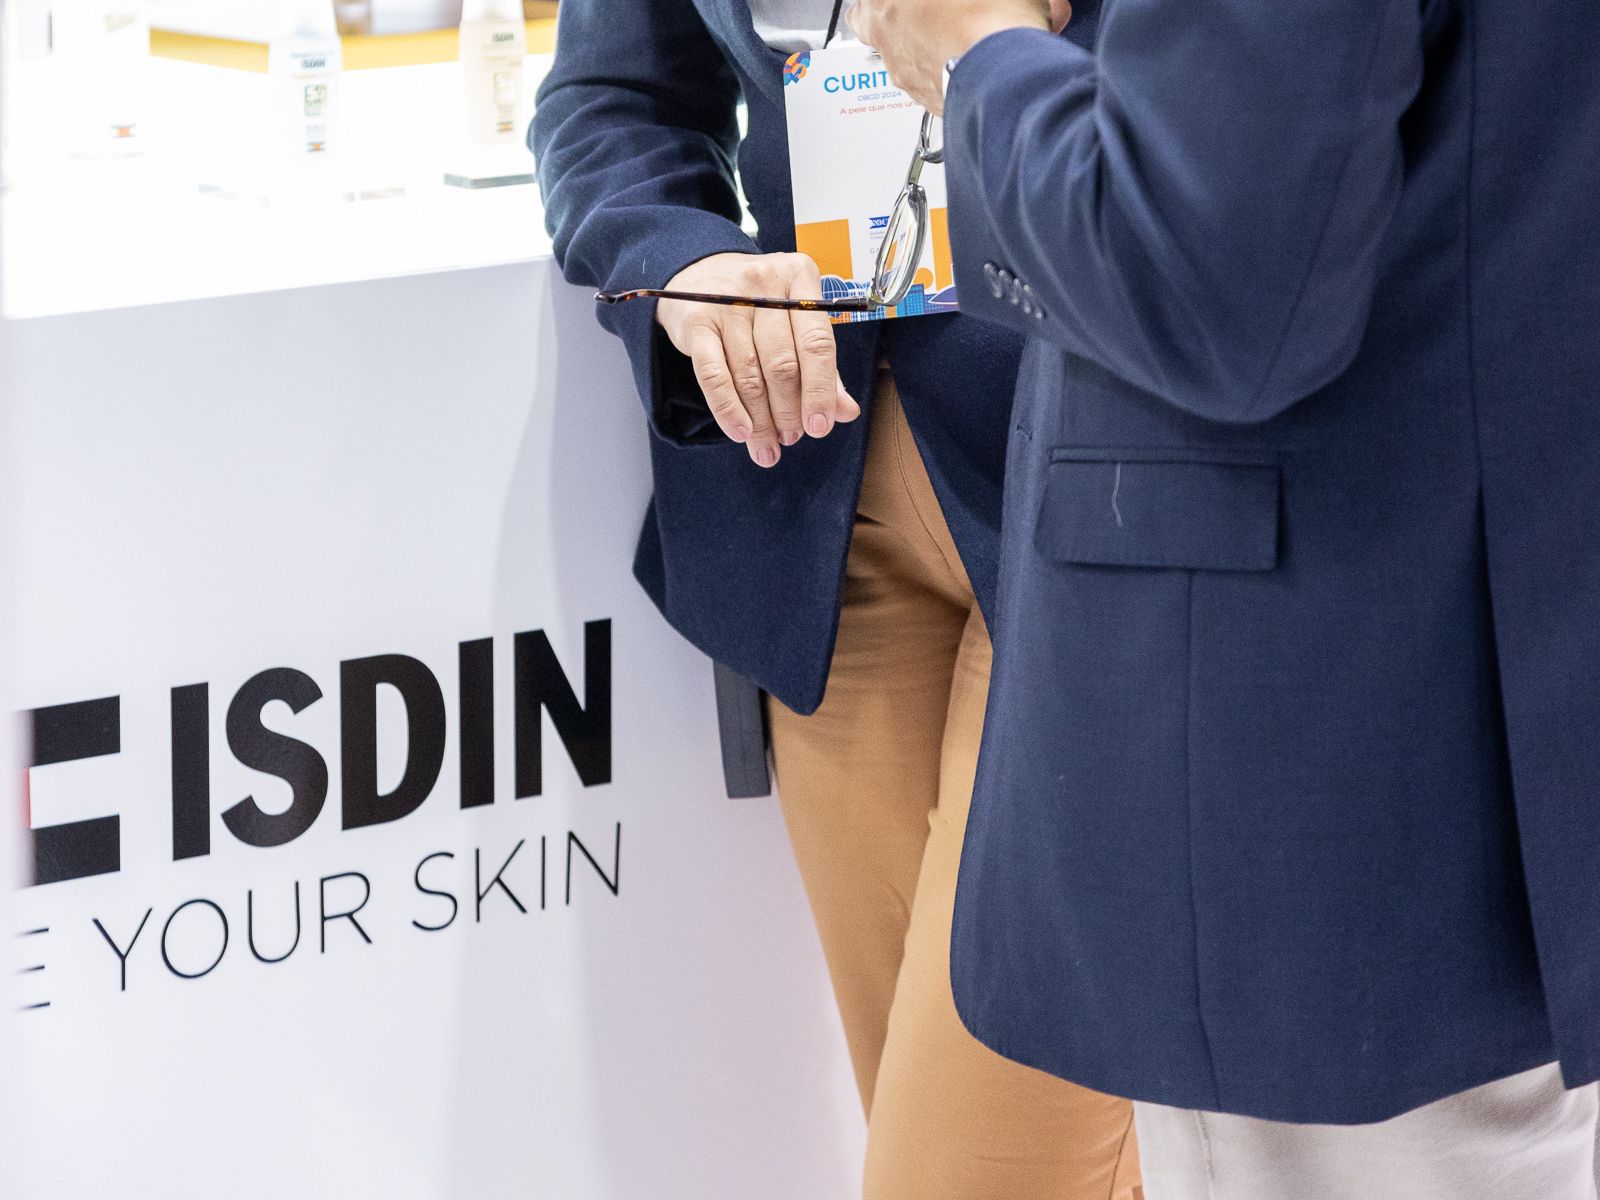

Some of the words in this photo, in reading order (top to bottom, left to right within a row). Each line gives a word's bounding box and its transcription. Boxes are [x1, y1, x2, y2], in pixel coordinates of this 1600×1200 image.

[849, 105, 867, 115] pele
[869, 103, 886, 112] que
[887, 101, 903, 109] nos
[882, 90, 902, 99] 2024
[171, 617, 612, 861] ISDIN
[92, 871, 373, 992] YOUR
[411, 822, 622, 932] SKIN
